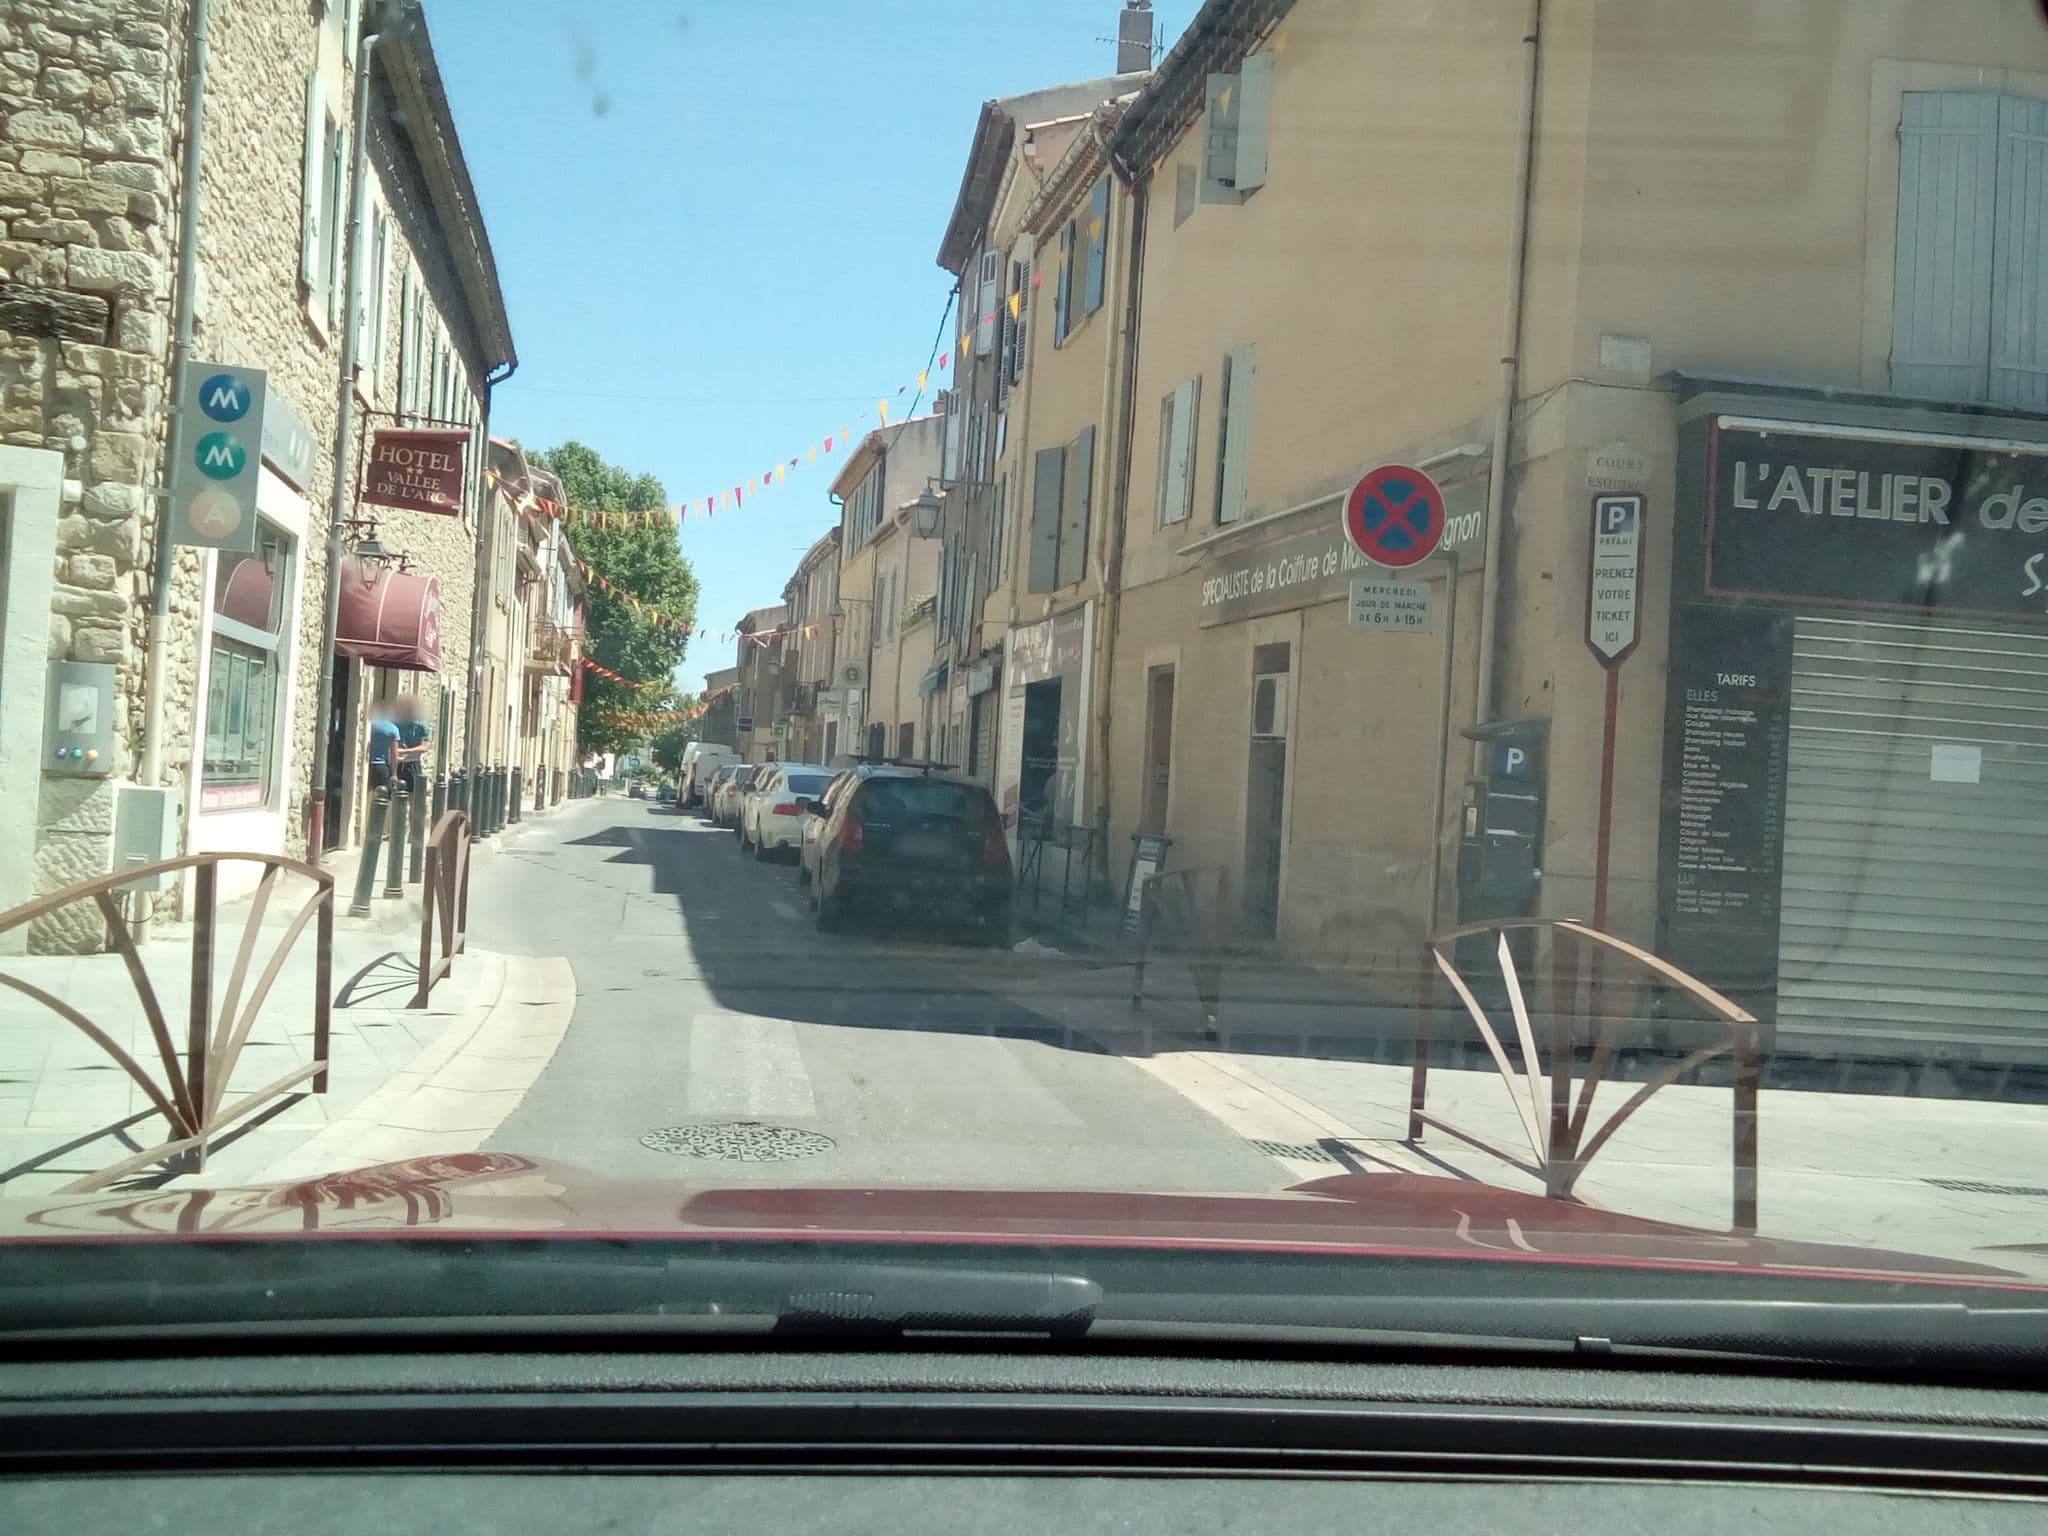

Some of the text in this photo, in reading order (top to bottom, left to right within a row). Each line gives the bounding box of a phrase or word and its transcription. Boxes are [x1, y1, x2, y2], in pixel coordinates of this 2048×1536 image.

[209, 387, 240, 410] M
[204, 445, 234, 468] M
[378, 445, 455, 472] HOTEL
[1596, 456, 1643, 471] COURS
[387, 471, 441, 491] VALLEE
[376, 482, 397, 496] DE
[1733, 461, 2048, 534] L'ATELIER de
[1608, 506, 1626, 530] P
[1250, 567, 1264, 594] de
[1265, 563, 1277, 590] la
[1279, 551, 1319, 587] Coiffure
[1322, 545, 1338, 577] de
[1440, 511, 1481, 551] gnon
[1595, 567, 1636, 579] PRENEZ
[1363, 586, 1417, 597] MERCREDI
[1597, 589, 1632, 601] VOTRE
[1356, 600, 1377, 609] JOUR
[1380, 601, 1391, 609] DE
[1359, 614, 1371, 623] DE
[1595, 610, 1631, 622] TICKET
[1604, 631, 1620, 643] ICI
[1716, 672, 1757, 688] TARIFS
[1685, 689, 1719, 702] ELLES
[1505, 748, 1524, 774] P
